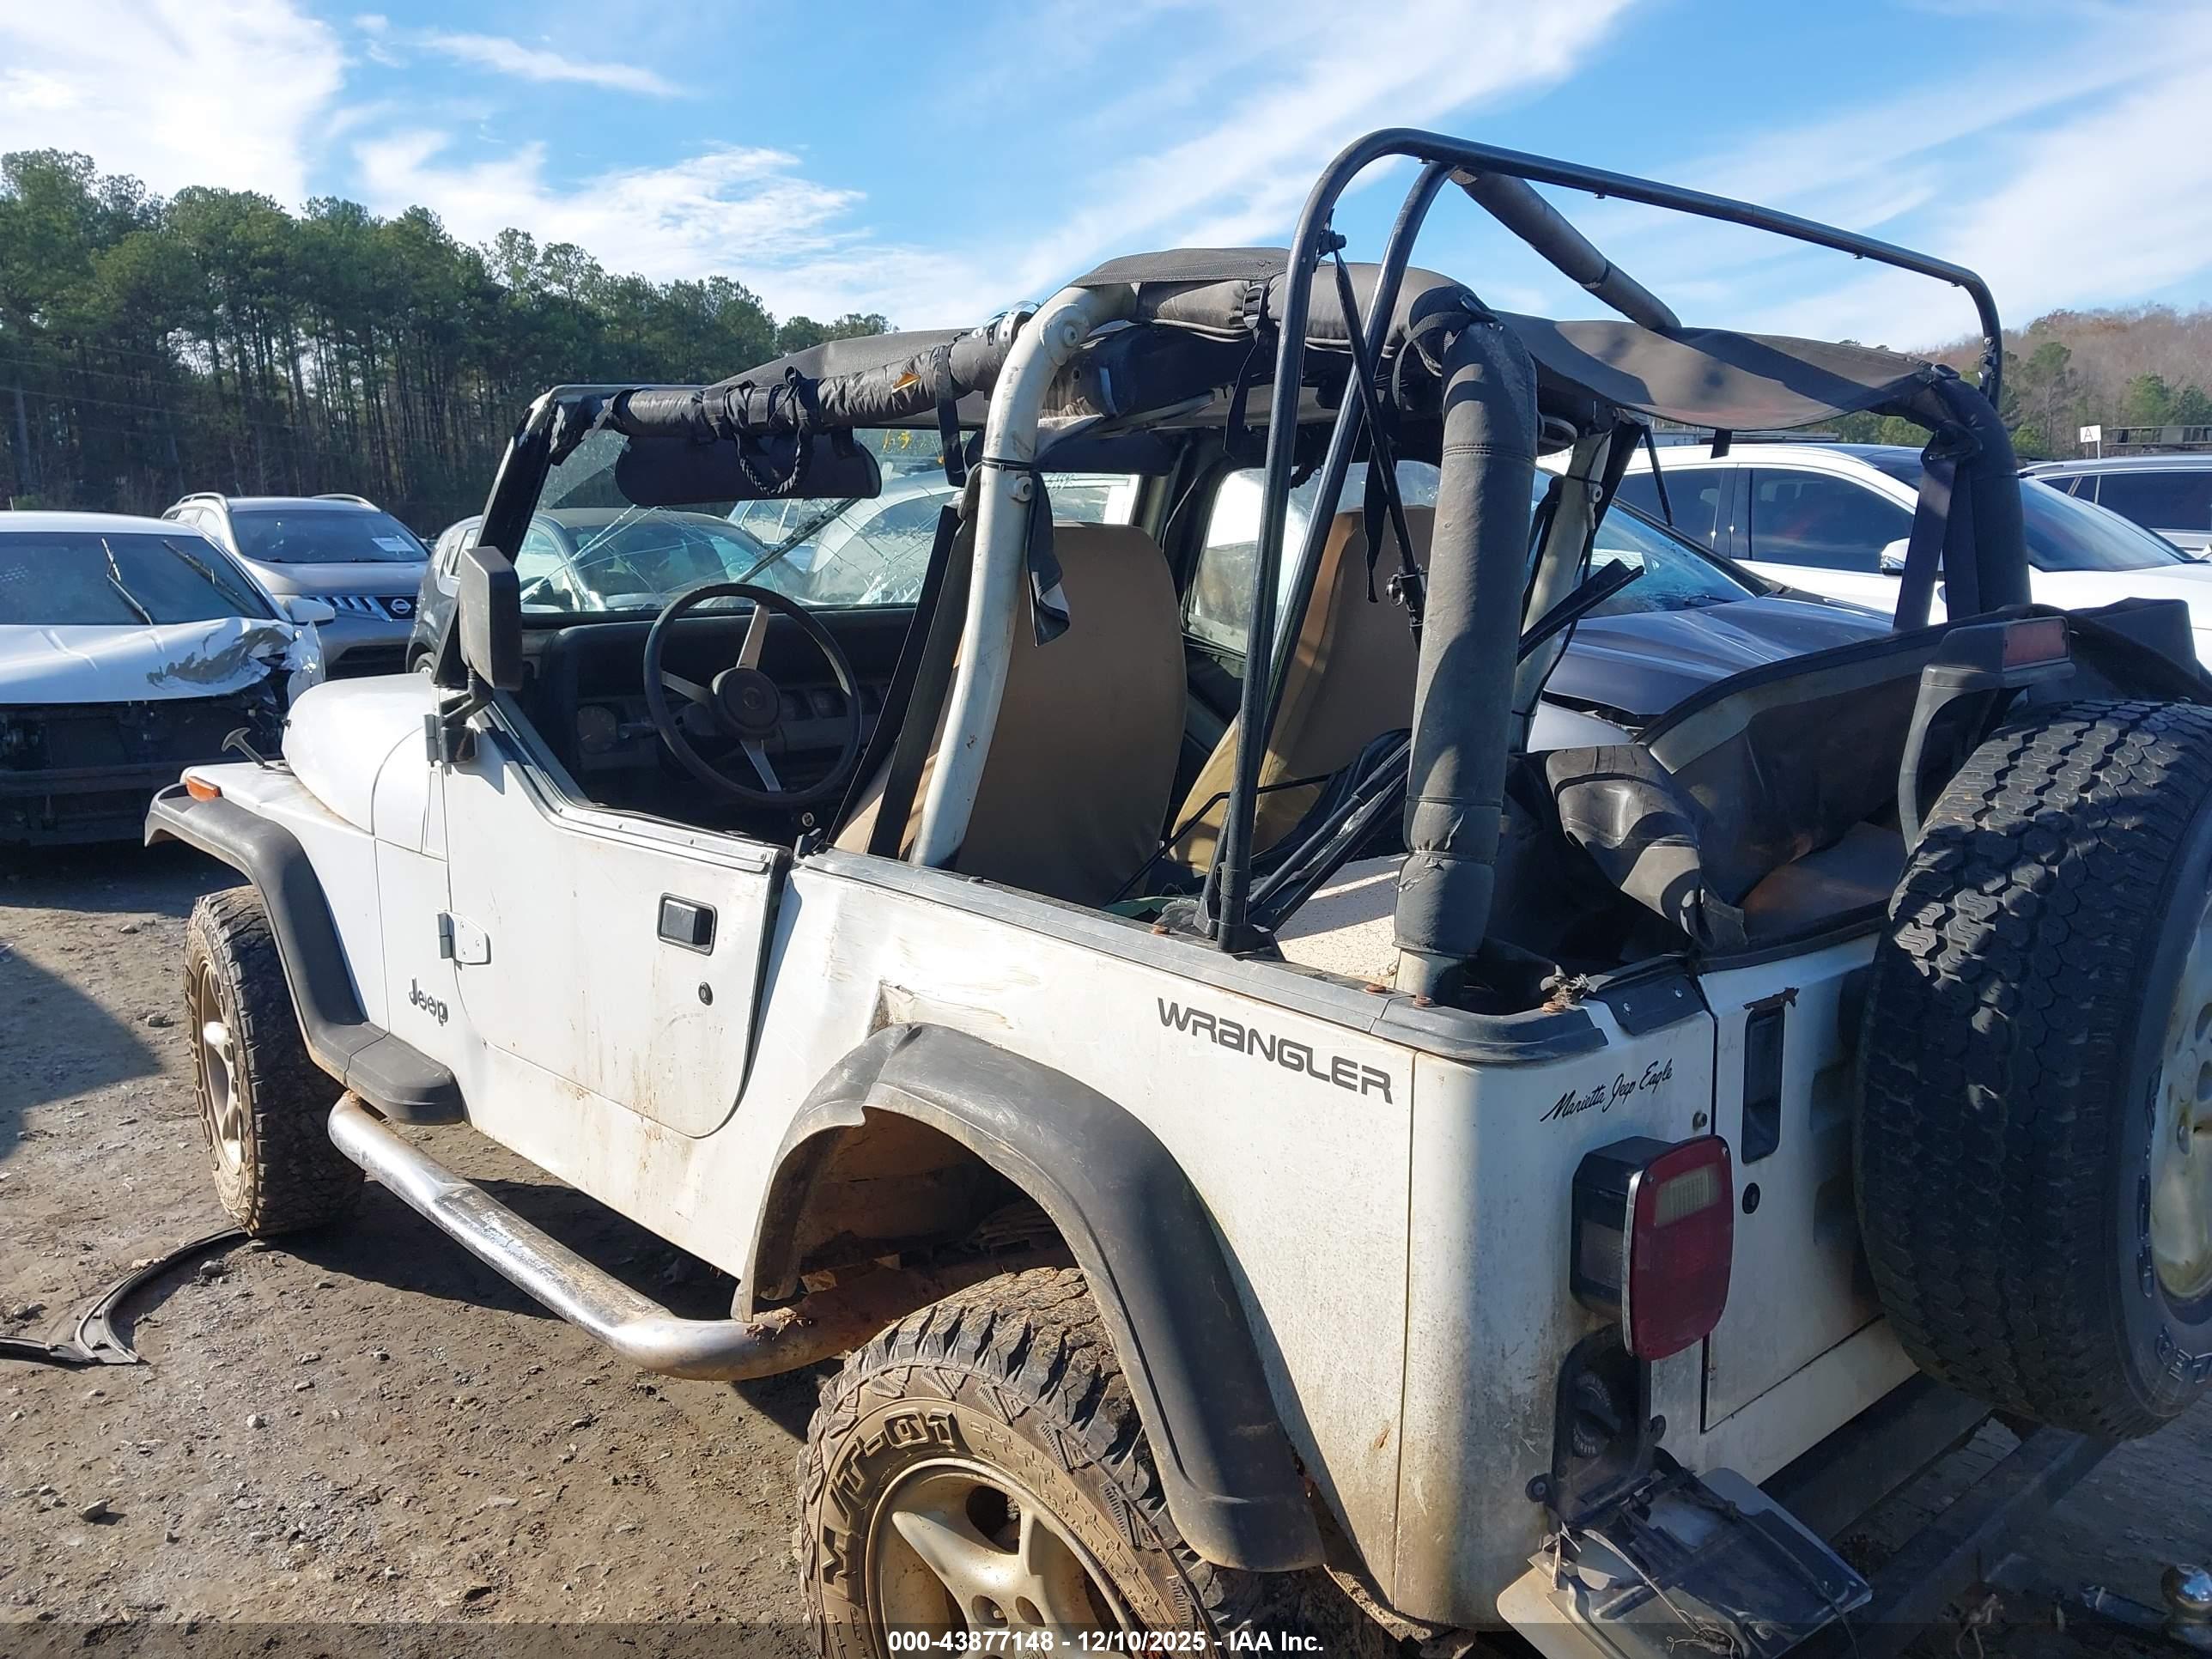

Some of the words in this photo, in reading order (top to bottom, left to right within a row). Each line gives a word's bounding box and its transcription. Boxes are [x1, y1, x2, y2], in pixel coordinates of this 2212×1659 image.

[2084, 428, 2094, 441] A
[409, 977, 448, 1026] Jeep
[1158, 997, 1393, 1105] WRANGLER
[1540, 1084, 1607, 1122] Marietta
[1602, 1073, 1636, 1113] Jeep
[1639, 1058, 1673, 1094] Eagle
